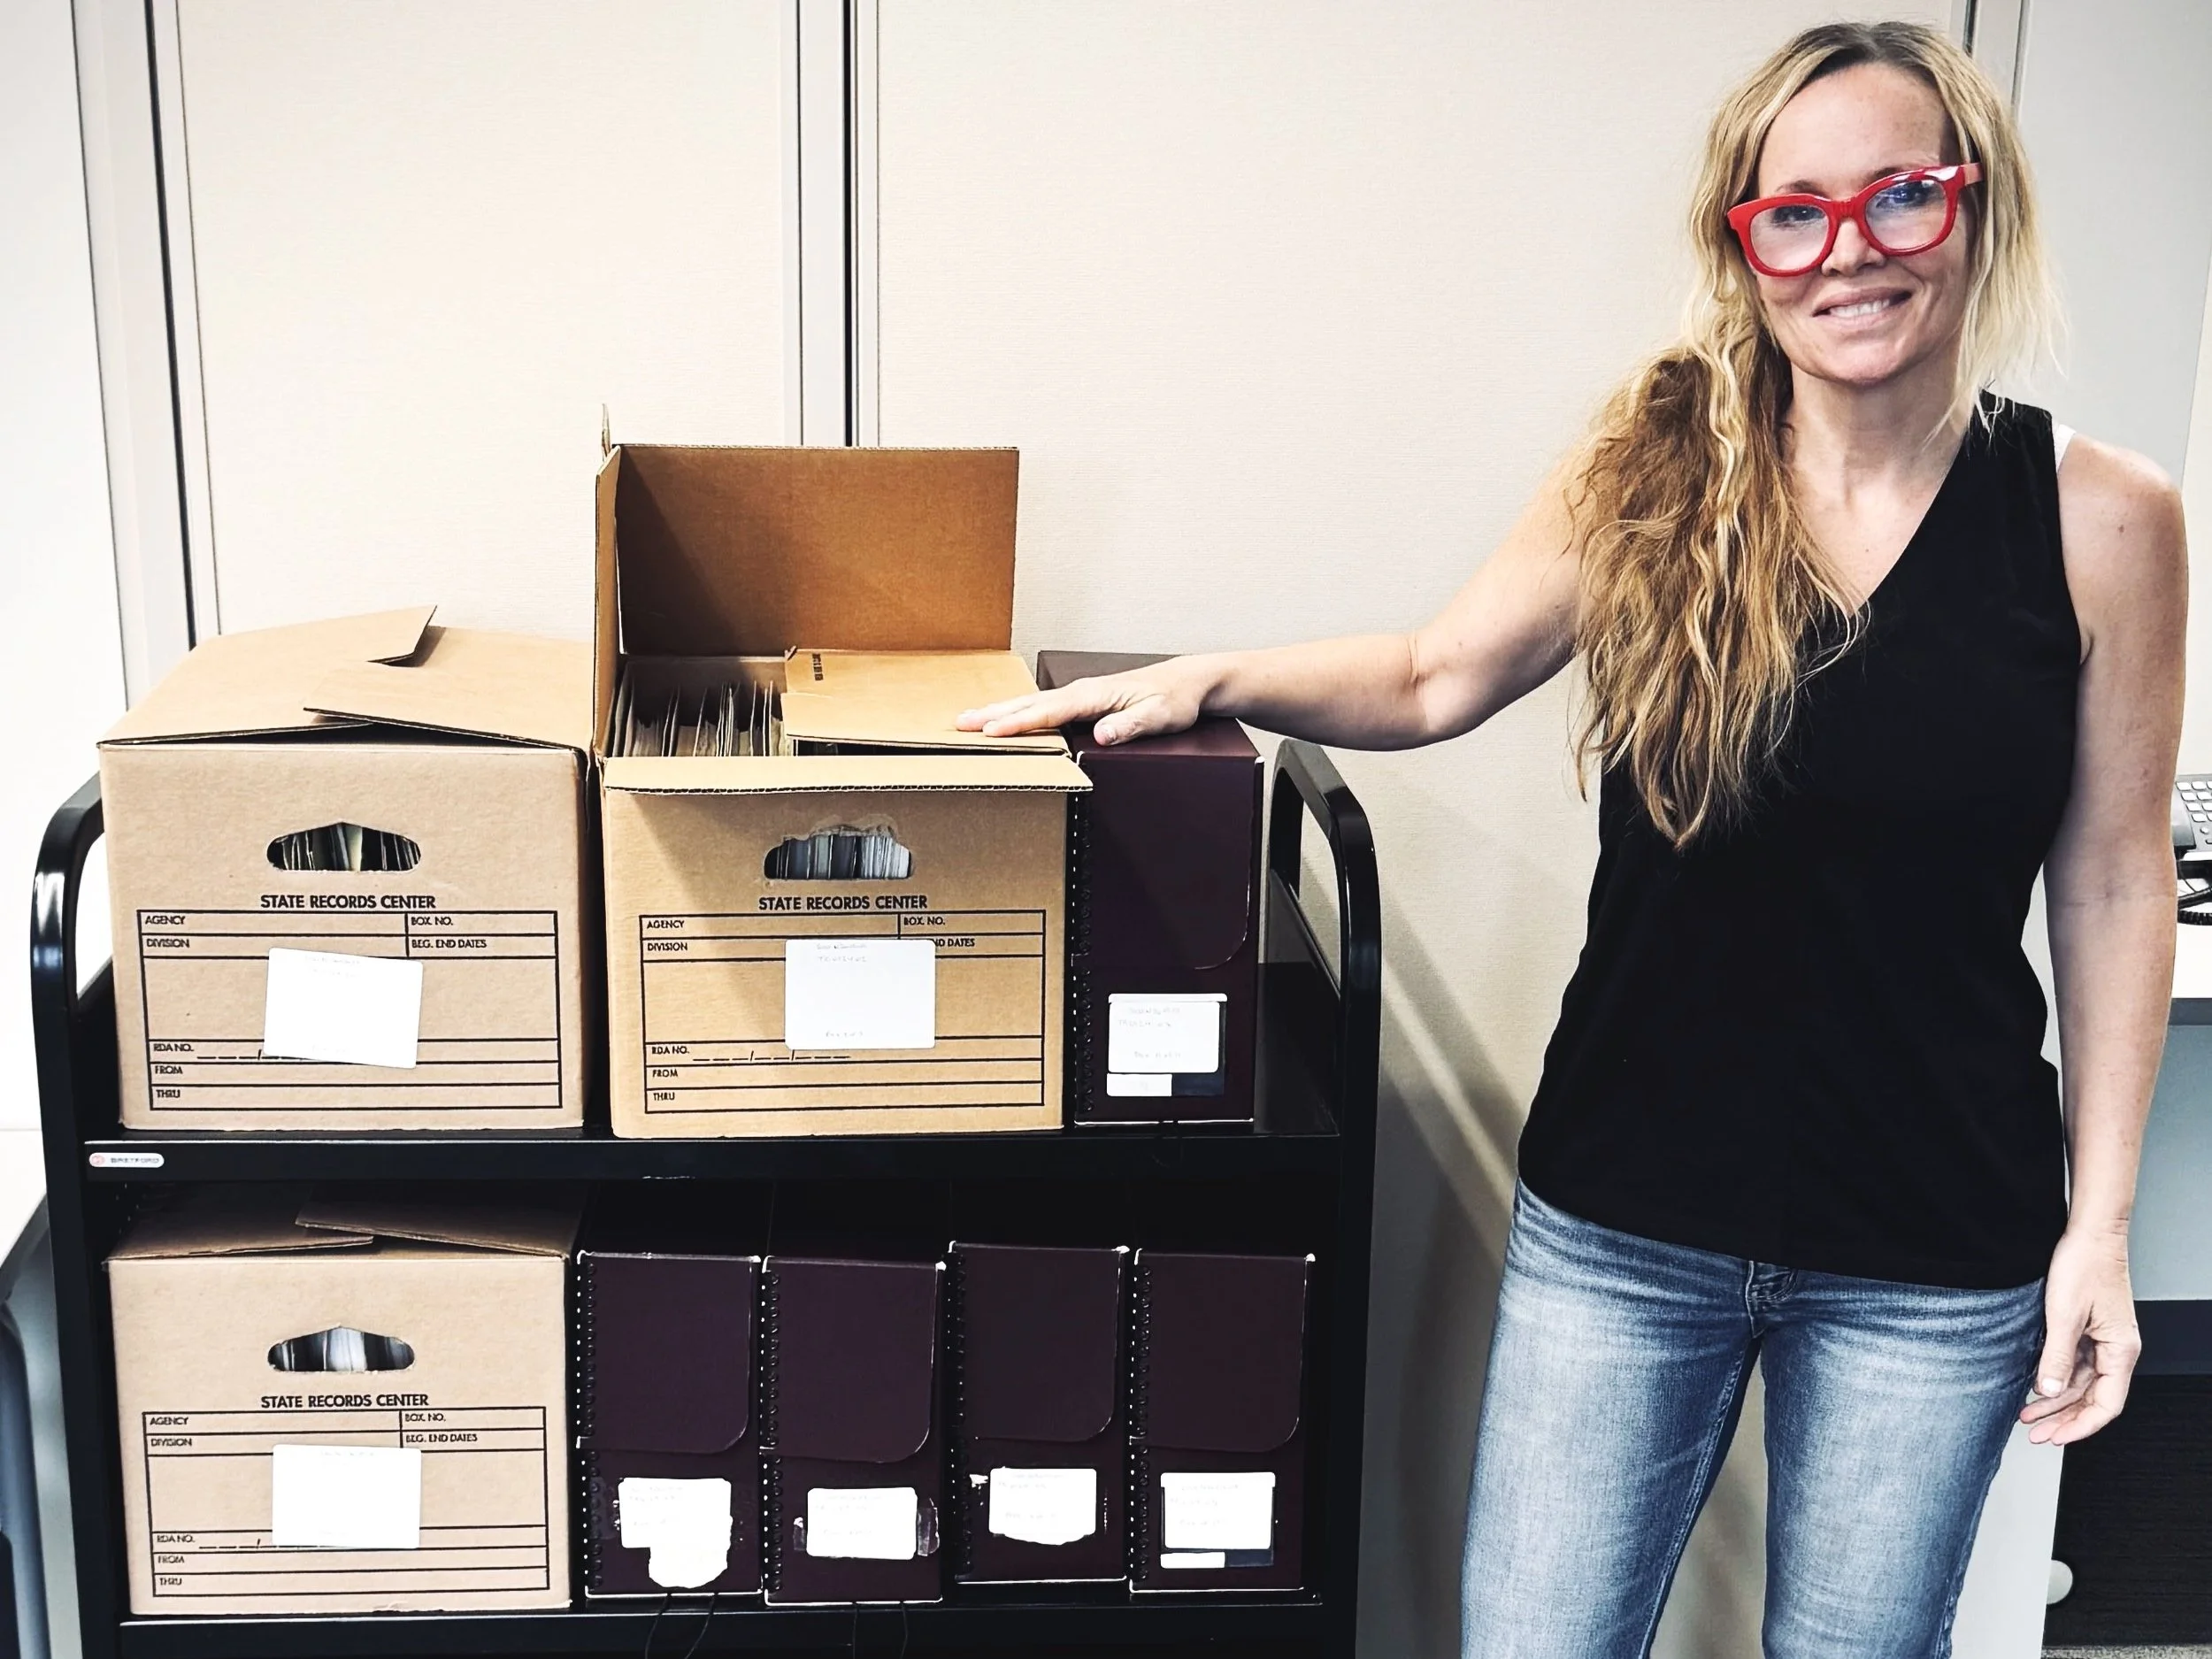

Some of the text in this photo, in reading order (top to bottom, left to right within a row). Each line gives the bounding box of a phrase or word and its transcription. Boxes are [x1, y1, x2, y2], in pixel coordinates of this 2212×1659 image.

[260, 895, 436, 909] STATE RECORDS CENTER
[758, 895, 927, 910] STATE RECORDS CENTER
[145, 915, 186, 925] AGENCY
[434, 917, 454, 926] NO.
[647, 919, 685, 929] AGENCY
[926, 916, 946, 926] NO.
[146, 938, 190, 948] DIVISION
[435, 939, 457, 949] END
[457, 939, 488, 949] DATES
[647, 942, 688, 951] DIVISION
[948, 938, 975, 948] DATES
[155, 1065, 183, 1074] FROM
[652, 1069, 679, 1078] FROM
[156, 1089, 180, 1098] THRU
[653, 1092, 675, 1101] THRU
[261, 1394, 429, 1409] STATE RECORDS CENTER
[150, 1417, 189, 1425] AGENCY
[150, 1438, 192, 1447] DIVISION
[428, 1433, 449, 1443] END
[449, 1433, 478, 1442] DATES
[157, 1555, 185, 1564] FROM
[159, 1577, 182, 1586] THRU
